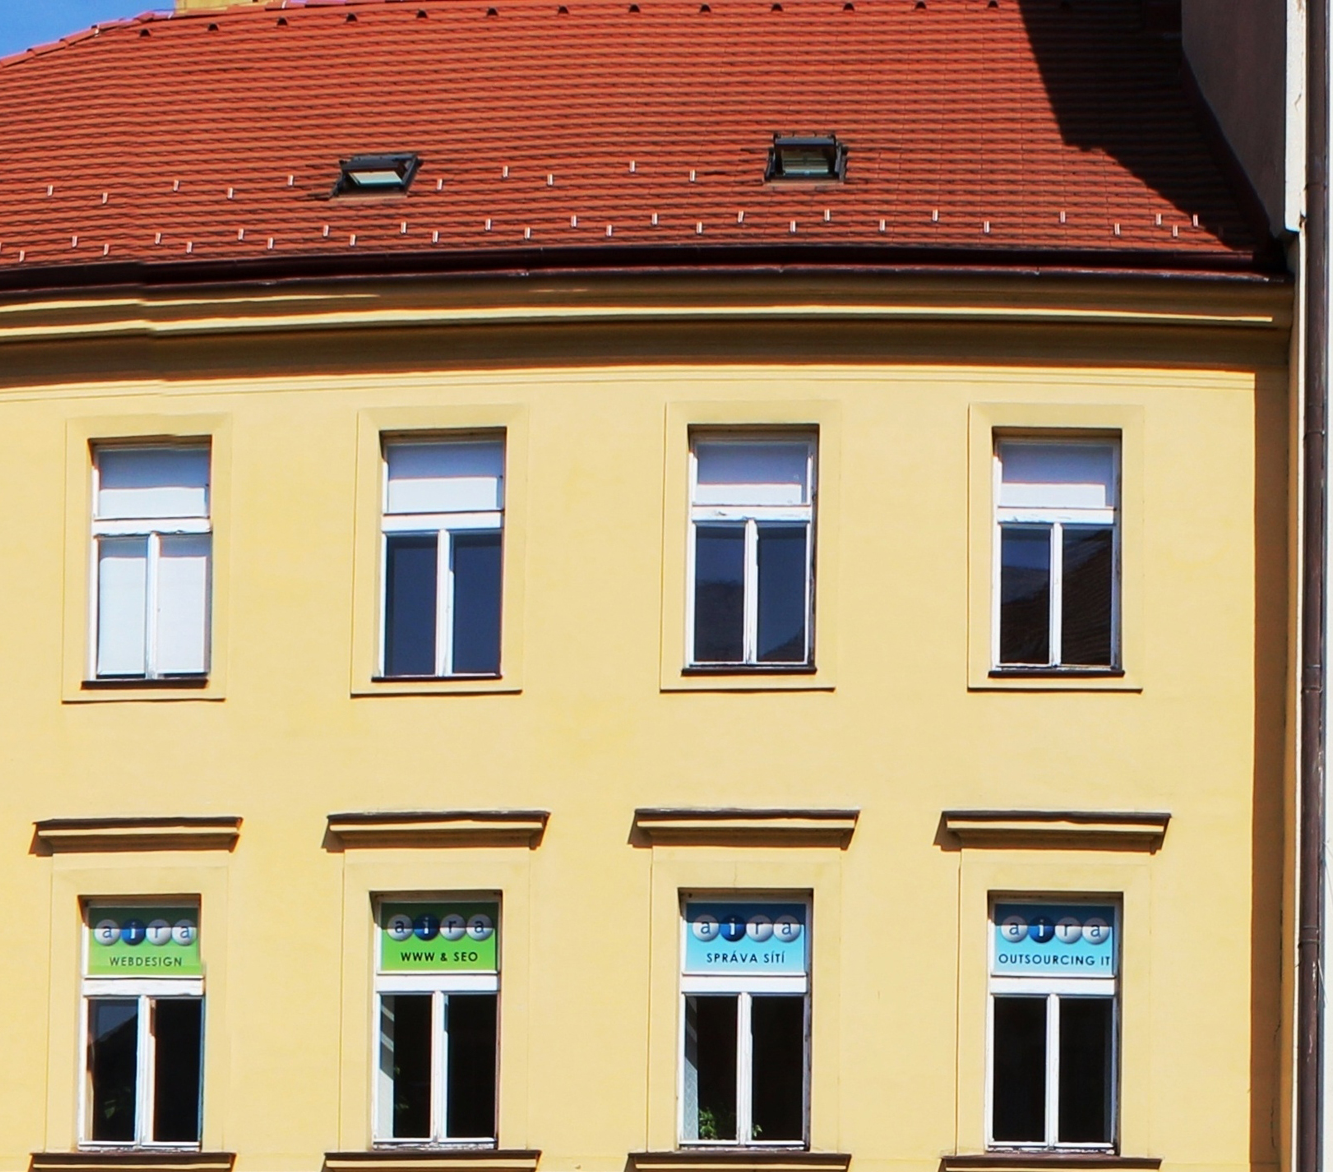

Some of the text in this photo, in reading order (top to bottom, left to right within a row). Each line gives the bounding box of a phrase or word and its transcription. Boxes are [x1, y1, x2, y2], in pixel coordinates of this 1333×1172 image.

[101, 921, 191, 940] aira
[393, 916, 485, 935] aira
[699, 917, 793, 937] aira
[1008, 918, 1102, 939] aira
[109, 956, 183, 967] WEBDESIGN
[400, 951, 479, 962] WWW & SEO
[706, 950, 786, 964] SPRÁVA SÍTÍ
[998, 953, 1111, 966] OUTSOURCING IT
